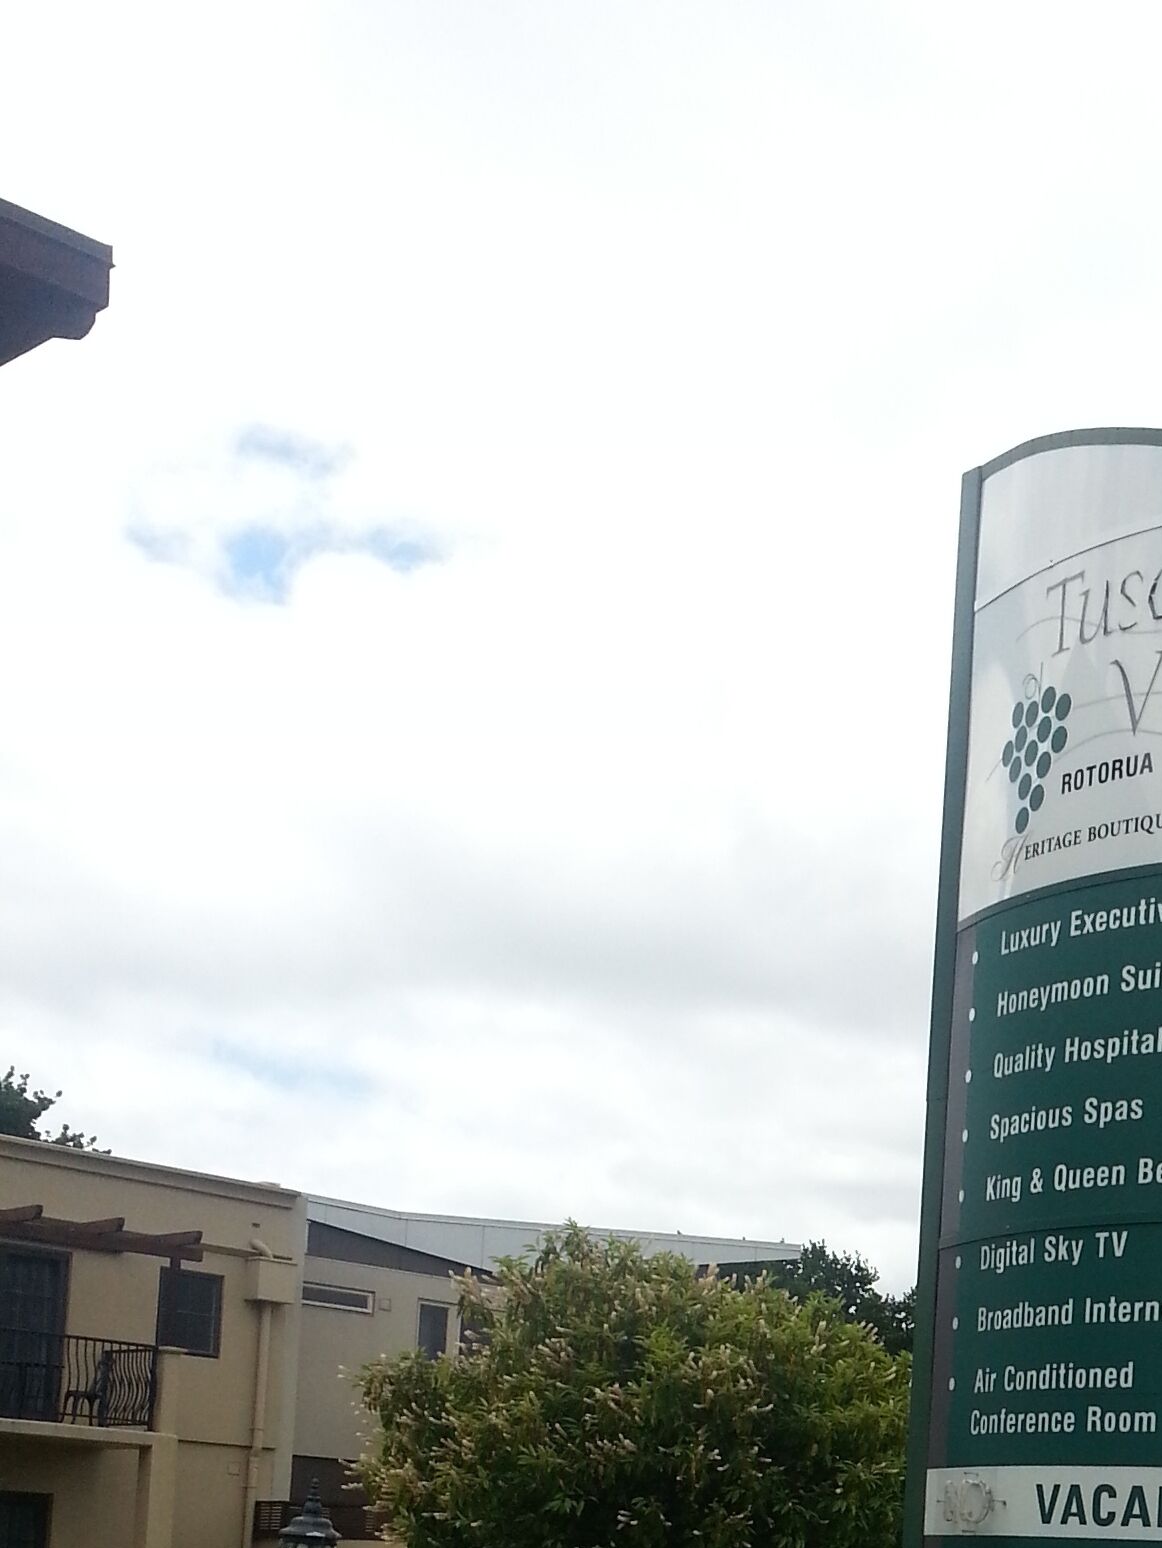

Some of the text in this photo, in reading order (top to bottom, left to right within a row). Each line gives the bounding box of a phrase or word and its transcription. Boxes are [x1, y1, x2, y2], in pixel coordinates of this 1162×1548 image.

[1061, 752, 1154, 794] ROTORUA
[1000, 920, 1062, 955] Luxury
[996, 973, 1110, 1017] Honeymoon
[993, 1043, 1056, 1079] Quality
[989, 1097, 1144, 1143] Spacious Spas
[985, 1174, 1022, 1203] King
[1029, 1167, 1044, 1194] &
[1053, 1162, 1126, 1192] Queen
[979, 1230, 1129, 1274] Digital Sky TV
[977, 1298, 1073, 1332] Broadband
[974, 1361, 1134, 1394] Air Conditioned
[970, 1405, 1157, 1436] Conference Room
